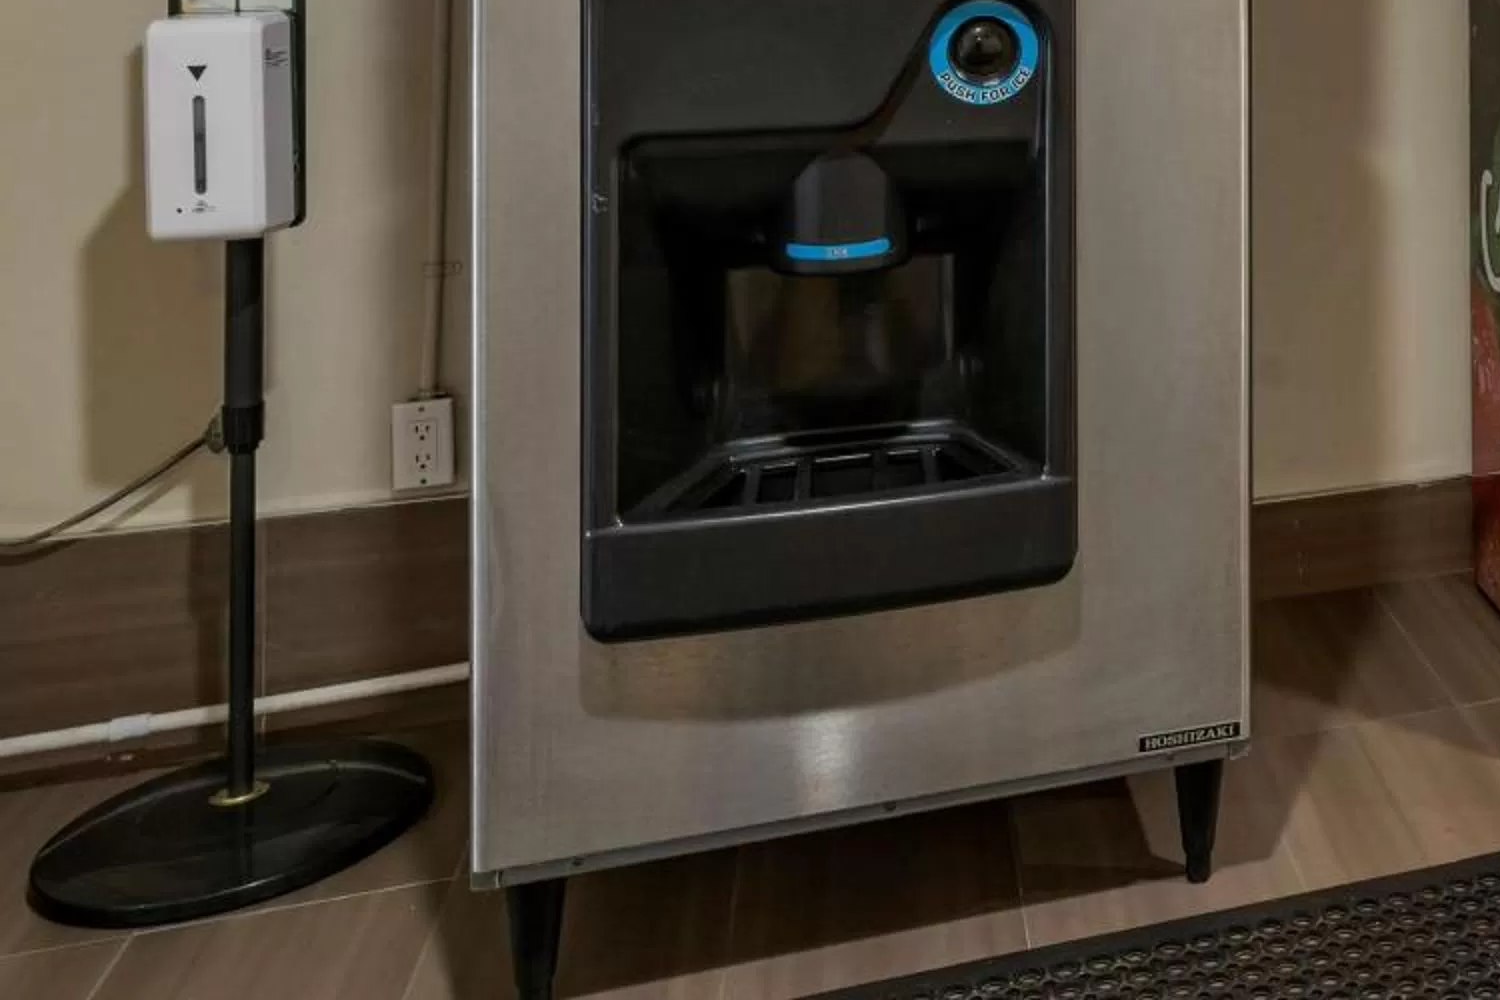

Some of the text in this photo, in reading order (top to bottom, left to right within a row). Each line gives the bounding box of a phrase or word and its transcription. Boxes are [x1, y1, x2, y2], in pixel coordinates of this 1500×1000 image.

[940, 66, 1031, 101] PUSH FOR ICE
[1145, 725, 1234, 750] HOSHIZAKI
